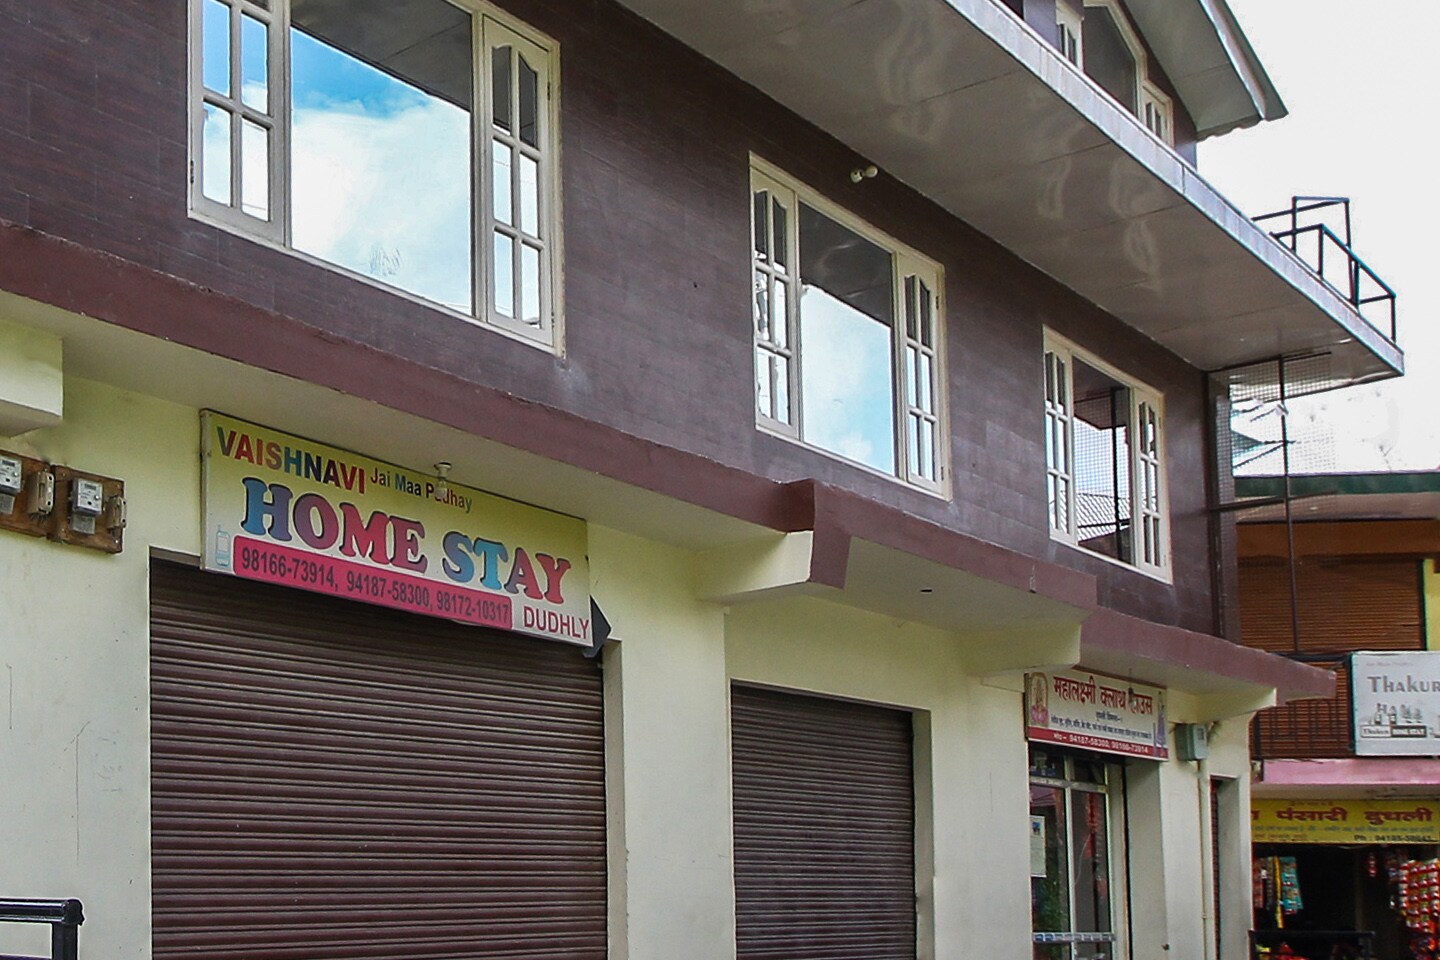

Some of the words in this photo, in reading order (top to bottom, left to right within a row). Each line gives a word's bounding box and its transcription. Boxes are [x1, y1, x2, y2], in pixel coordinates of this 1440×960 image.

[216, 426, 366, 494] VAISHNAVI
[370, 467, 391, 487] Jai
[394, 473, 422, 497] Maa
[240, 476, 428, 574] HOME
[442, 530, 572, 604] STAY
[242, 546, 339, 590] 98166-73914,
[346, 570, 433, 612] 94187-58300,
[436, 590, 510, 624] 98172-10317
[523, 605, 590, 640] DUDHLY
